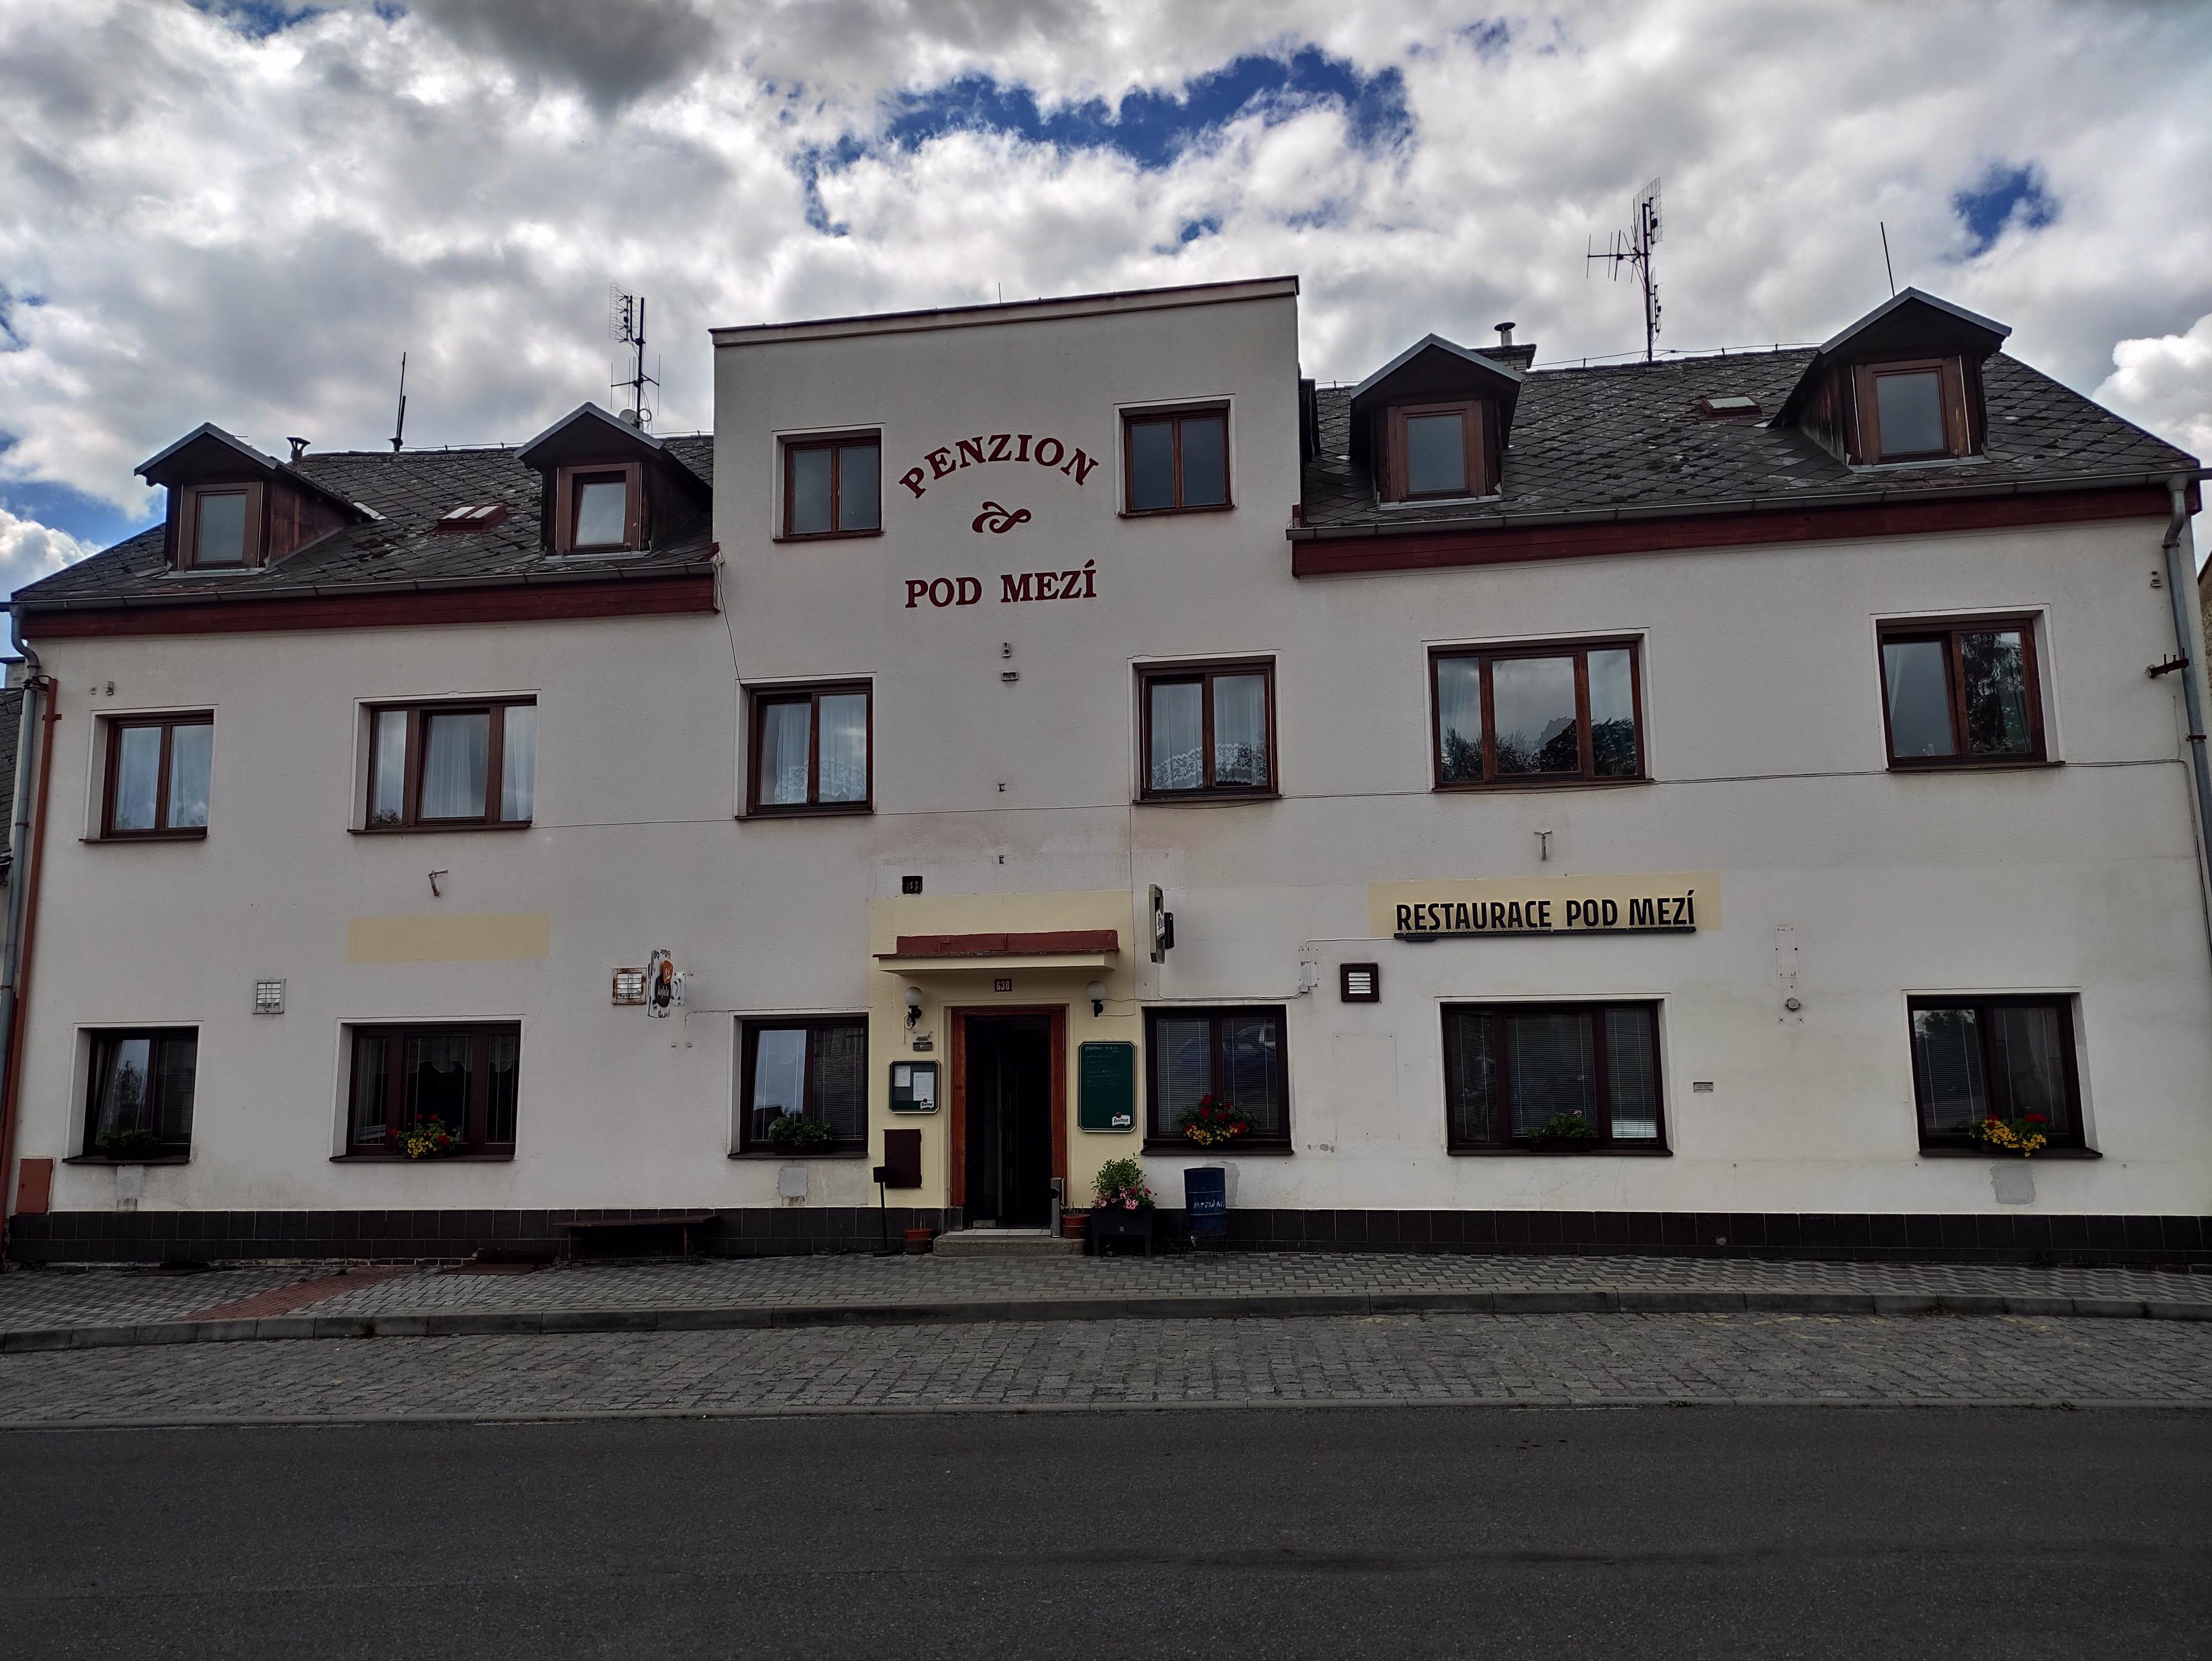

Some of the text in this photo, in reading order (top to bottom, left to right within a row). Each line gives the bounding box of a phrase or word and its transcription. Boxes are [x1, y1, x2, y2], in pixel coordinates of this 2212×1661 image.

[899, 434, 1099, 499] PENZION
[905, 559, 1097, 608] POD MEZÍ
[1396, 889, 1694, 931] RESTAURACE POD MEZÍ
[996, 981, 1009, 991] 638
